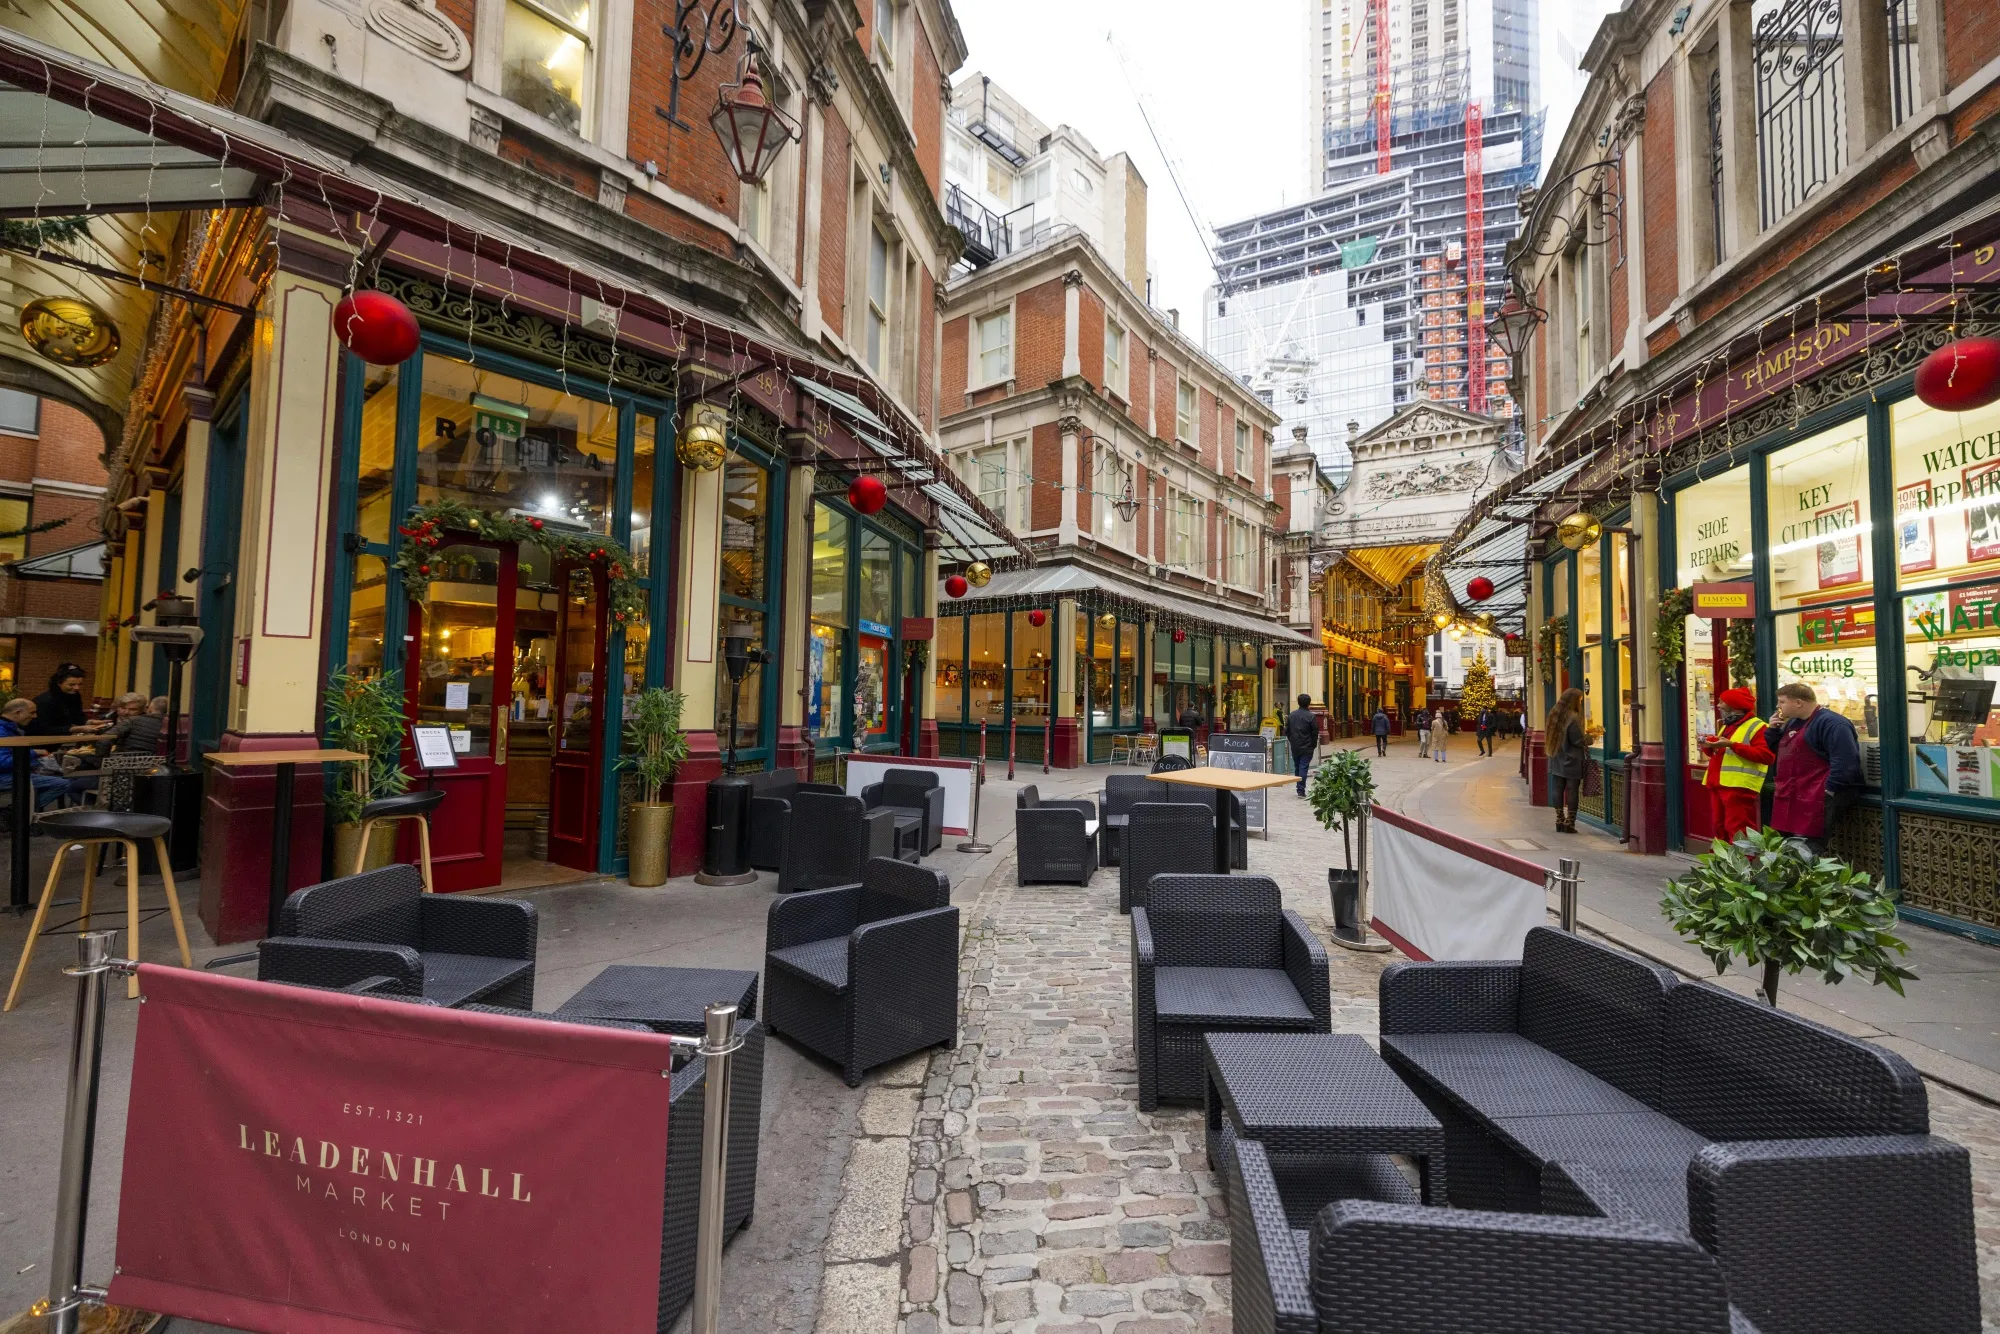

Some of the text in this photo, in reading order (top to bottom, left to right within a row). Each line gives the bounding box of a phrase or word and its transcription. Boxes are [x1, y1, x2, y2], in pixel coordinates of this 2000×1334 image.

[1391, 52, 1401, 60] 39
[1741, 323, 1852, 390] TIMPSON
[756, 373, 773, 396] 48
[816, 420, 829, 438] 47
[435, 416, 604, 472] ROCCA
[1922, 430, 2000, 475] WATCH
[1799, 483, 1833, 511] KEY
[1697, 516, 1729, 542] SHOE
[1782, 508, 1855, 545] CUTTING
[1690, 540, 1739, 569] REPAIRS
[1694, 629, 1708, 637] Fair
[1796, 619, 1845, 647] KEY
[1790, 653, 1855, 678] Cutting
[1223, 738, 1250, 748] ROCCA
[343, 1103, 425, 1126] EST.1321
[238, 1123, 532, 1202] LEADENHALL
[296, 1175, 451, 1221] MARKET
[339, 1227, 411, 1253] LONDON
